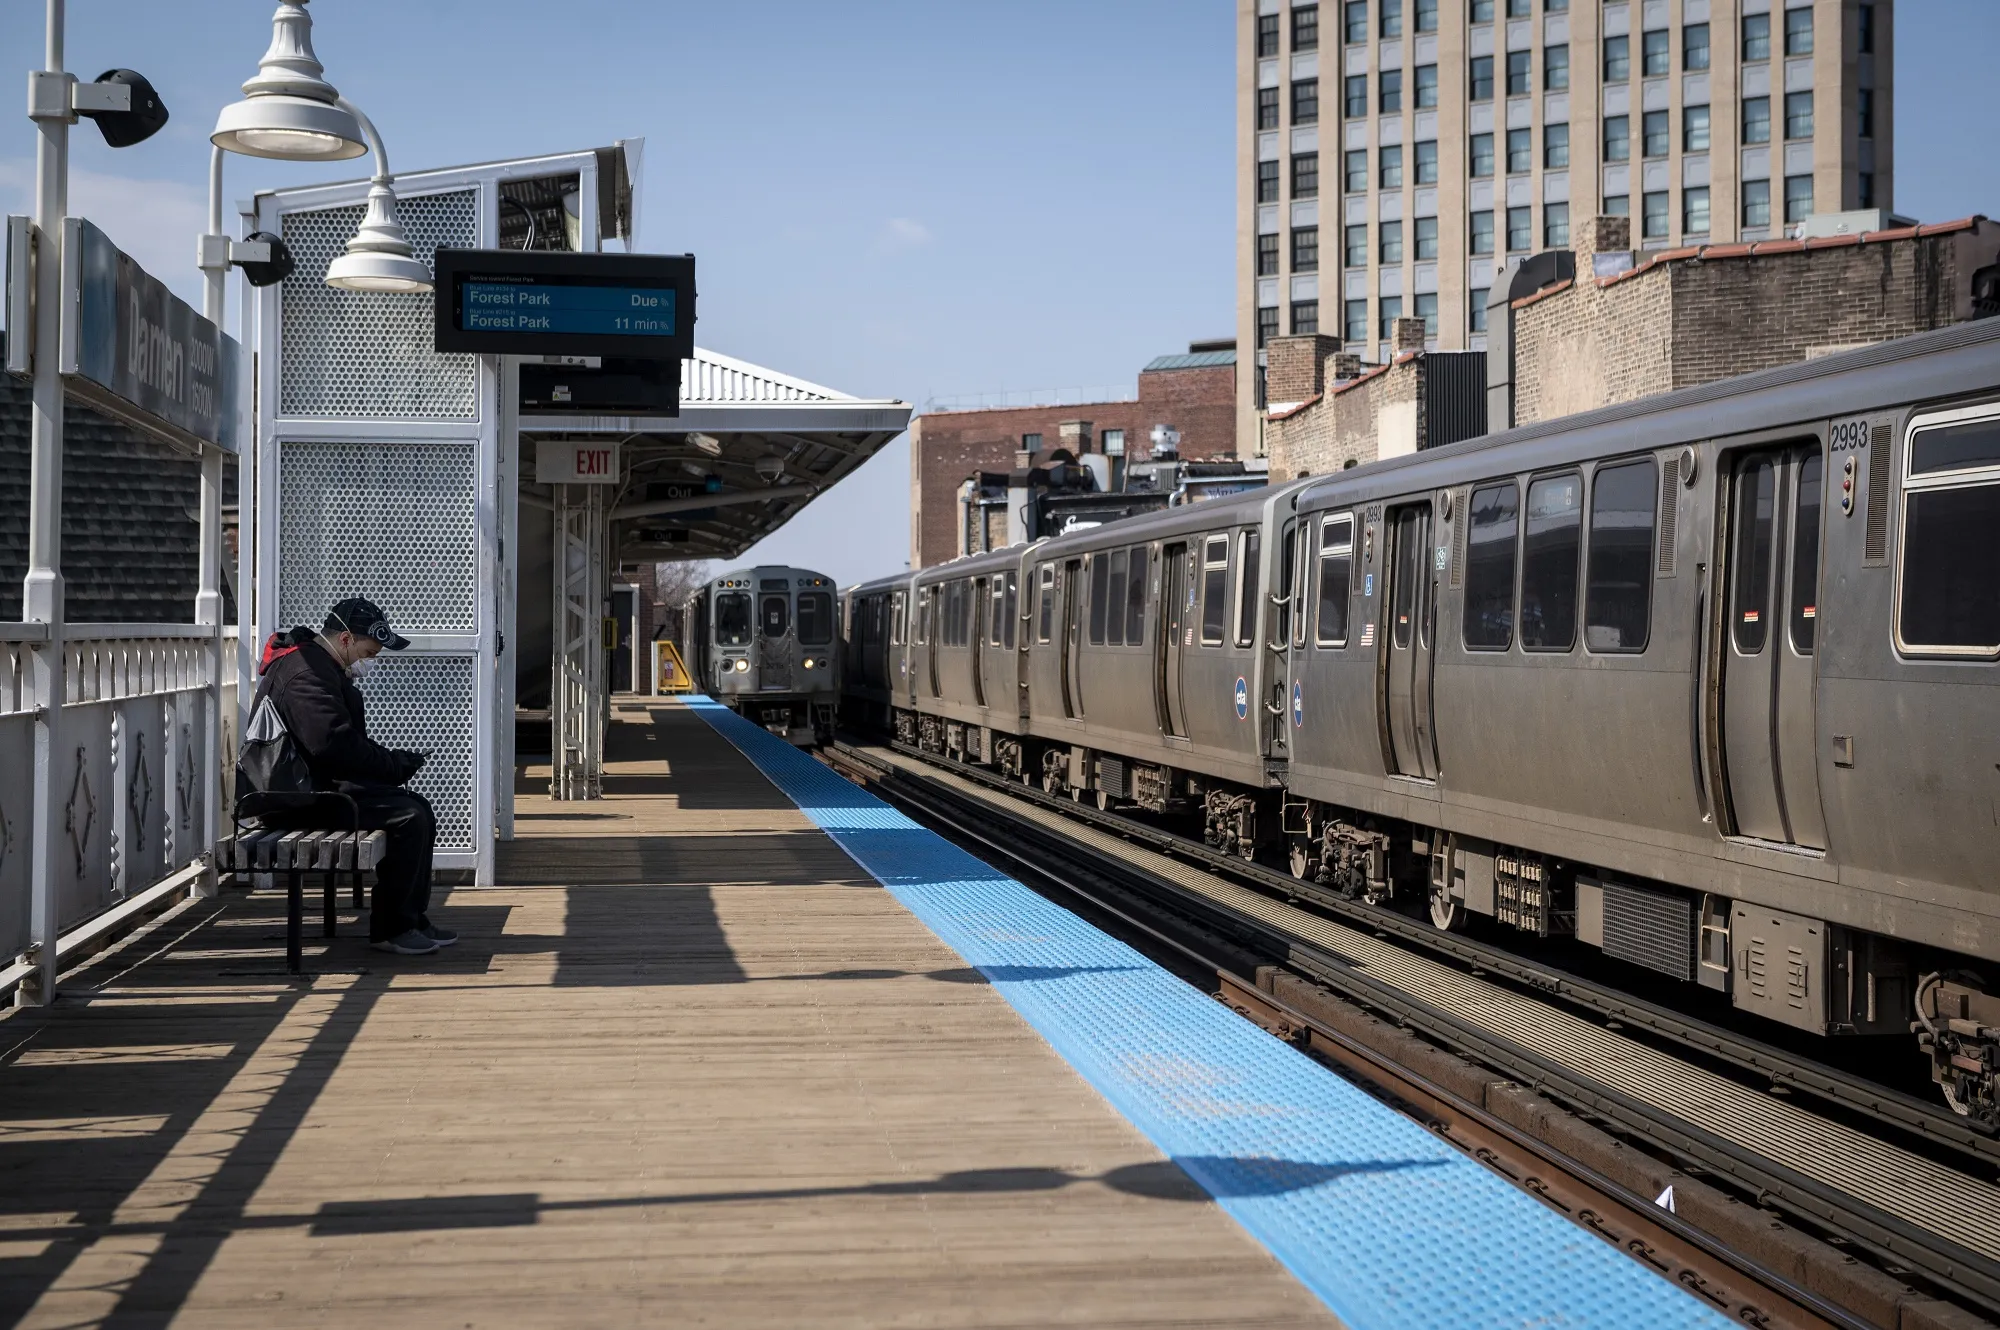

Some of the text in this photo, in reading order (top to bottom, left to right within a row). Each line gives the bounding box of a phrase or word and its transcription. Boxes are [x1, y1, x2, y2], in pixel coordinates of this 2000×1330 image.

[470, 291, 551, 305] Forest Park
[631, 294, 658, 308] Due
[470, 314, 551, 329] Forest Park
[614, 317, 658, 330] 11 min
[128, 285, 184, 404] Damen
[190, 335, 215, 378] 2000W
[191, 380, 214, 418] 1600N
[1831, 420, 1868, 452] 2993
[576, 449, 610, 475] EXIT
[667, 485, 693, 499] Out
[1366, 505, 1382, 523] 2993
[654, 531, 673, 541] Out
[376, 627, 388, 641] C
[1236, 690, 1246, 705] cta
